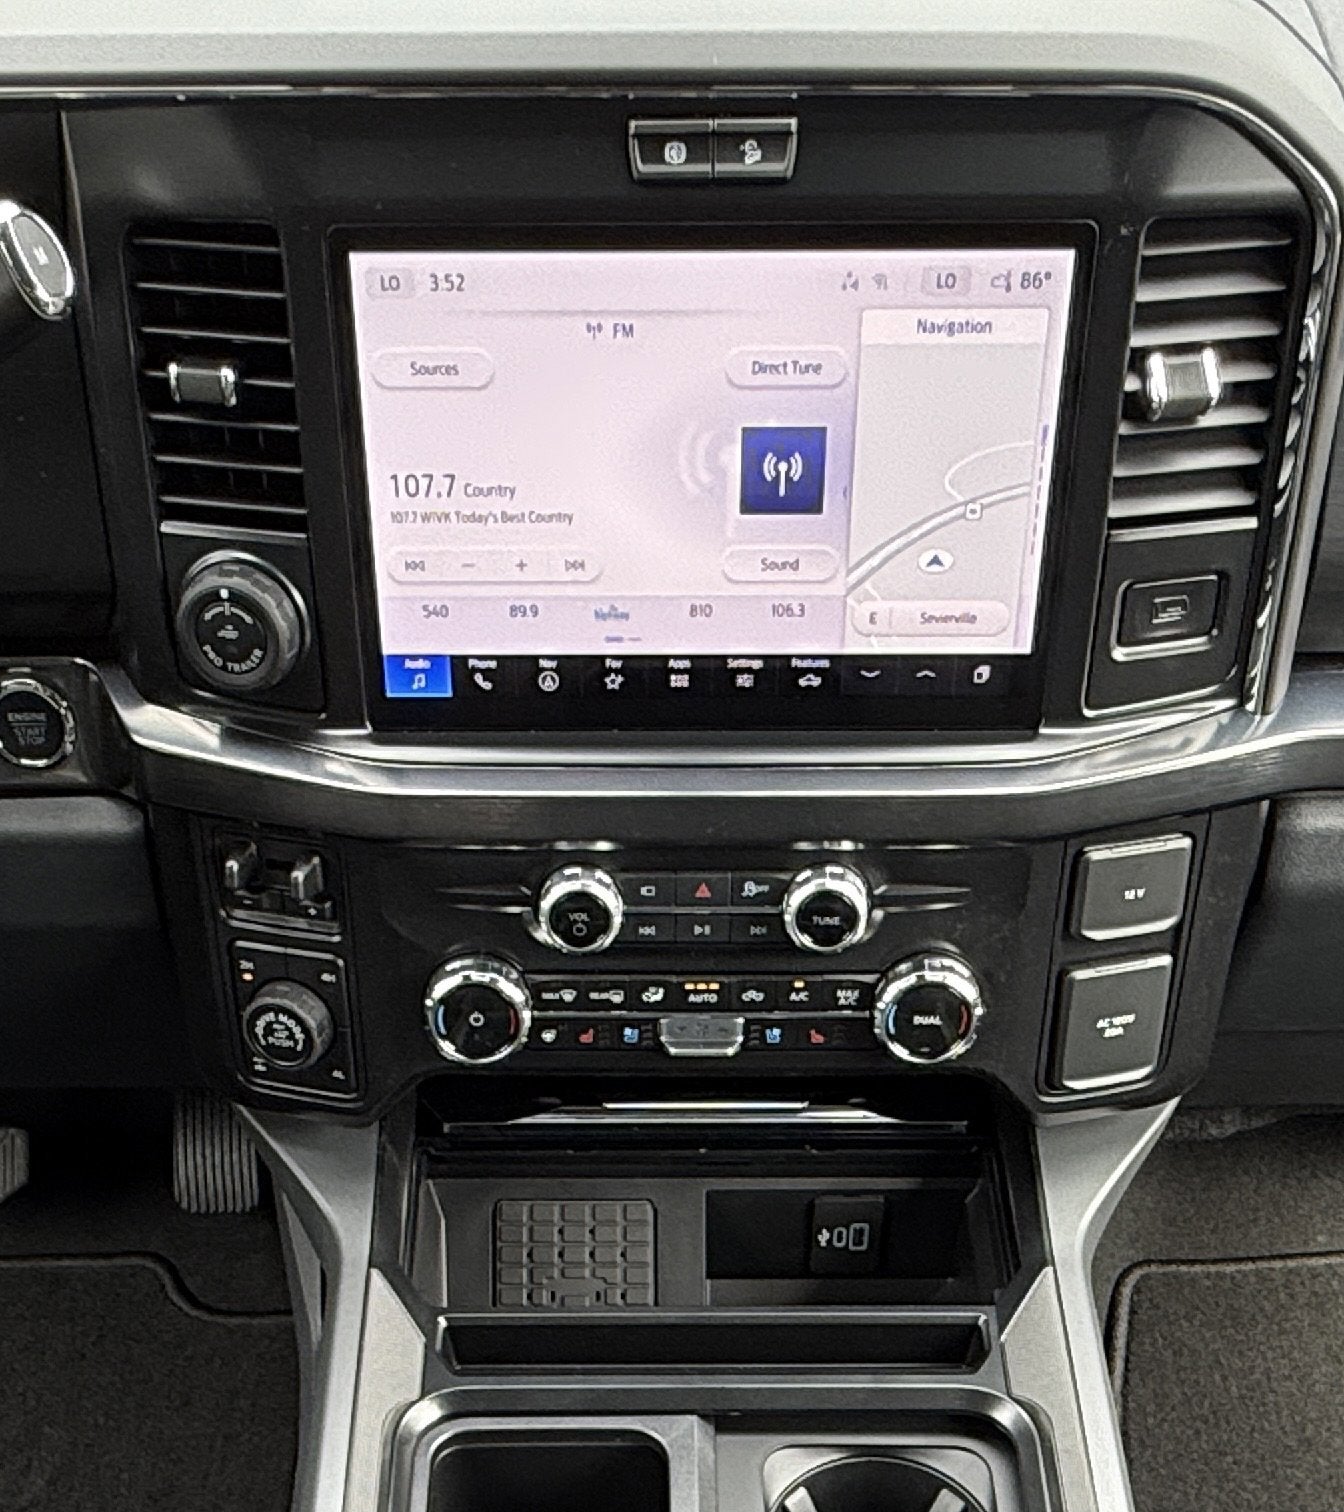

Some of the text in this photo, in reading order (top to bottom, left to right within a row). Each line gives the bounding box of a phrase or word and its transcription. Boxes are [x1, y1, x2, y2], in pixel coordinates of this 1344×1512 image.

[379, 272, 466, 293] LO 3:52
[935, 272, 957, 290] LO
[612, 322, 635, 339] FM
[915, 318, 993, 337] Navigation
[409, 360, 460, 377] Sources
[750, 360, 823, 376] Direct Tune
[389, 473, 517, 500] 107.7 Country
[455, 510, 500, 526] Today's
[500, 510, 527, 524] Best
[527, 510, 575, 526] Country
[759, 558, 801, 573] Sound
[421, 604, 451, 619] 540
[508, 604, 540, 619] 89.9
[689, 604, 714, 619] 810
[770, 604, 807, 619] 106.3
[919, 611, 979, 626] Sevierville
[467, 657, 498, 670] Phone
[13, 727, 46, 737] START
[18, 736, 46, 746] STOP
[567, 912, 591, 923] VOL
[812, 915, 840, 926] TUNE
[688, 993, 718, 1004] AUTO
[788, 991, 810, 1002] A/C
[912, 1014, 943, 1026] DUAL
